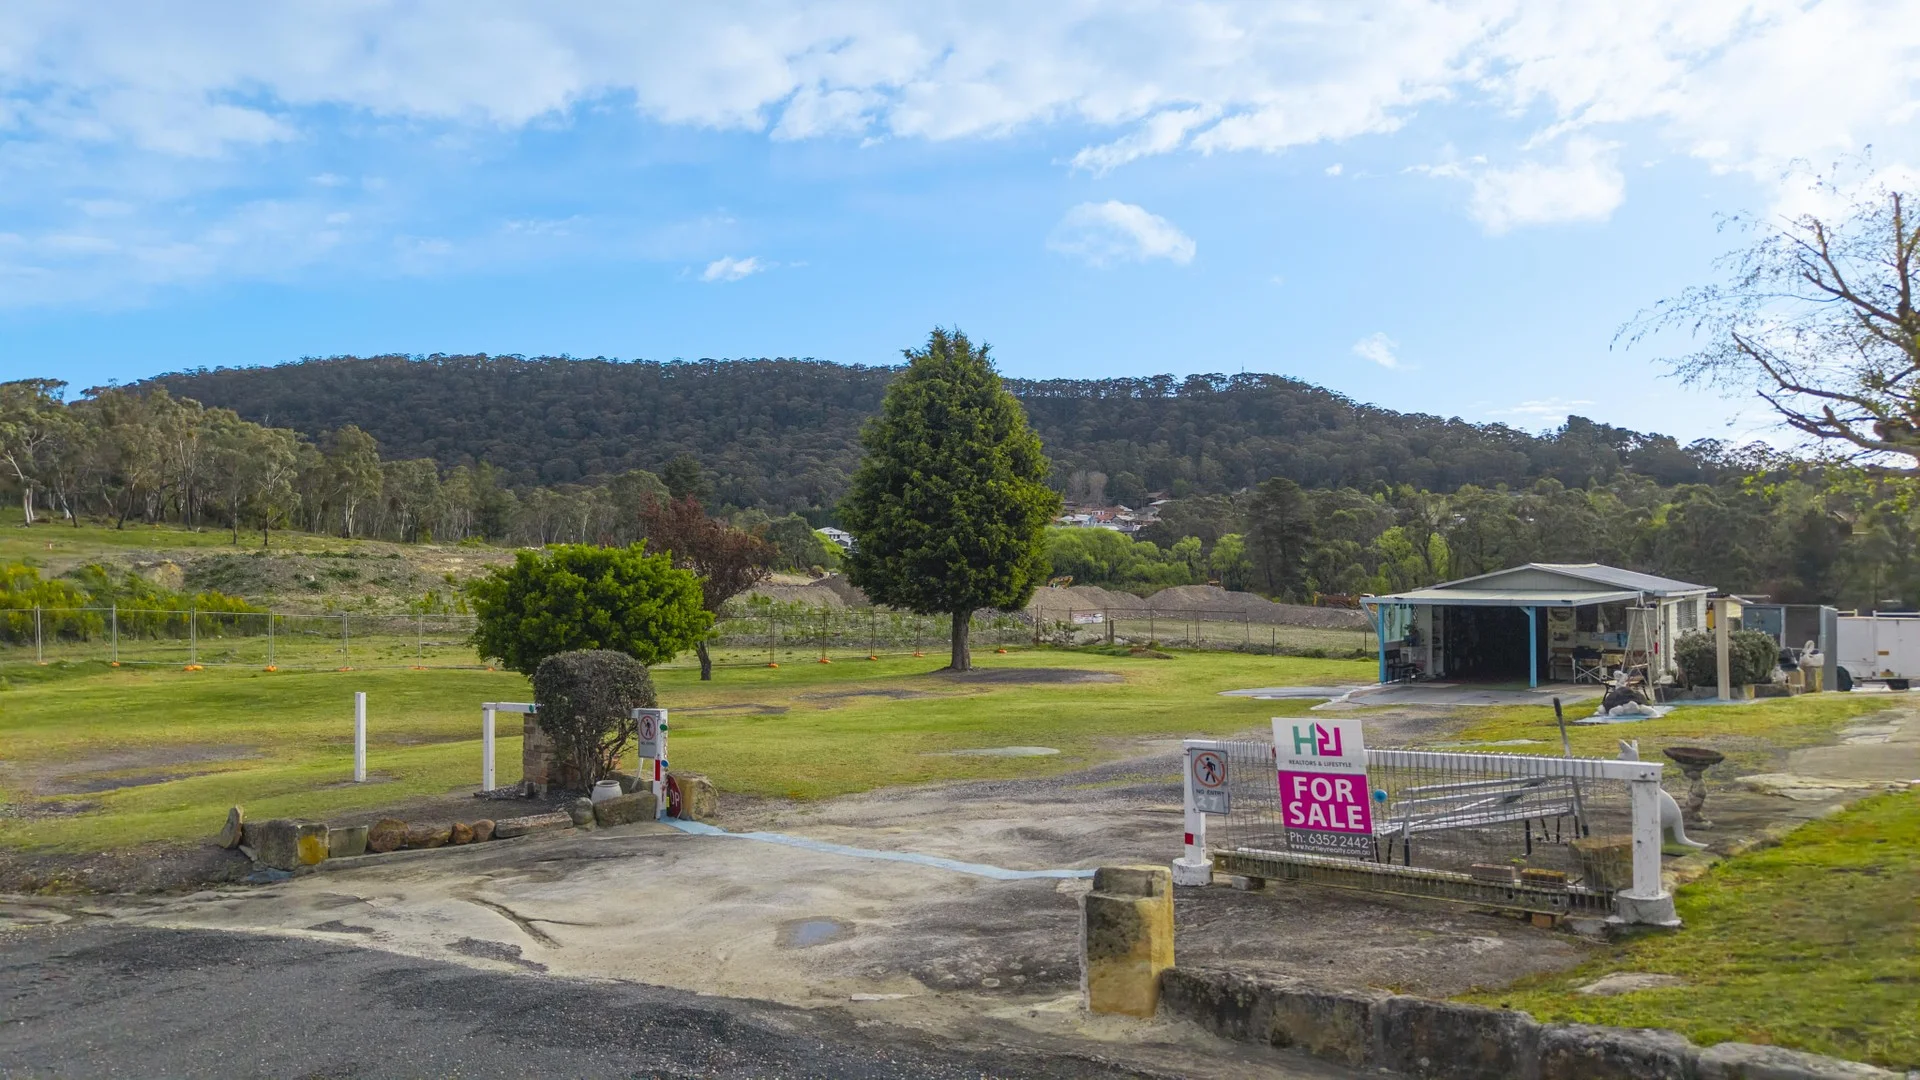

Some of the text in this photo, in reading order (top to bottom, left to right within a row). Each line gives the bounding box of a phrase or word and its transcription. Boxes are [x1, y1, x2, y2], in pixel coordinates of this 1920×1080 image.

[1293, 776, 1354, 803] FOR
[1289, 802, 1364, 829] SALE
[1290, 832, 1369, 849] Ph: 6352 2442
